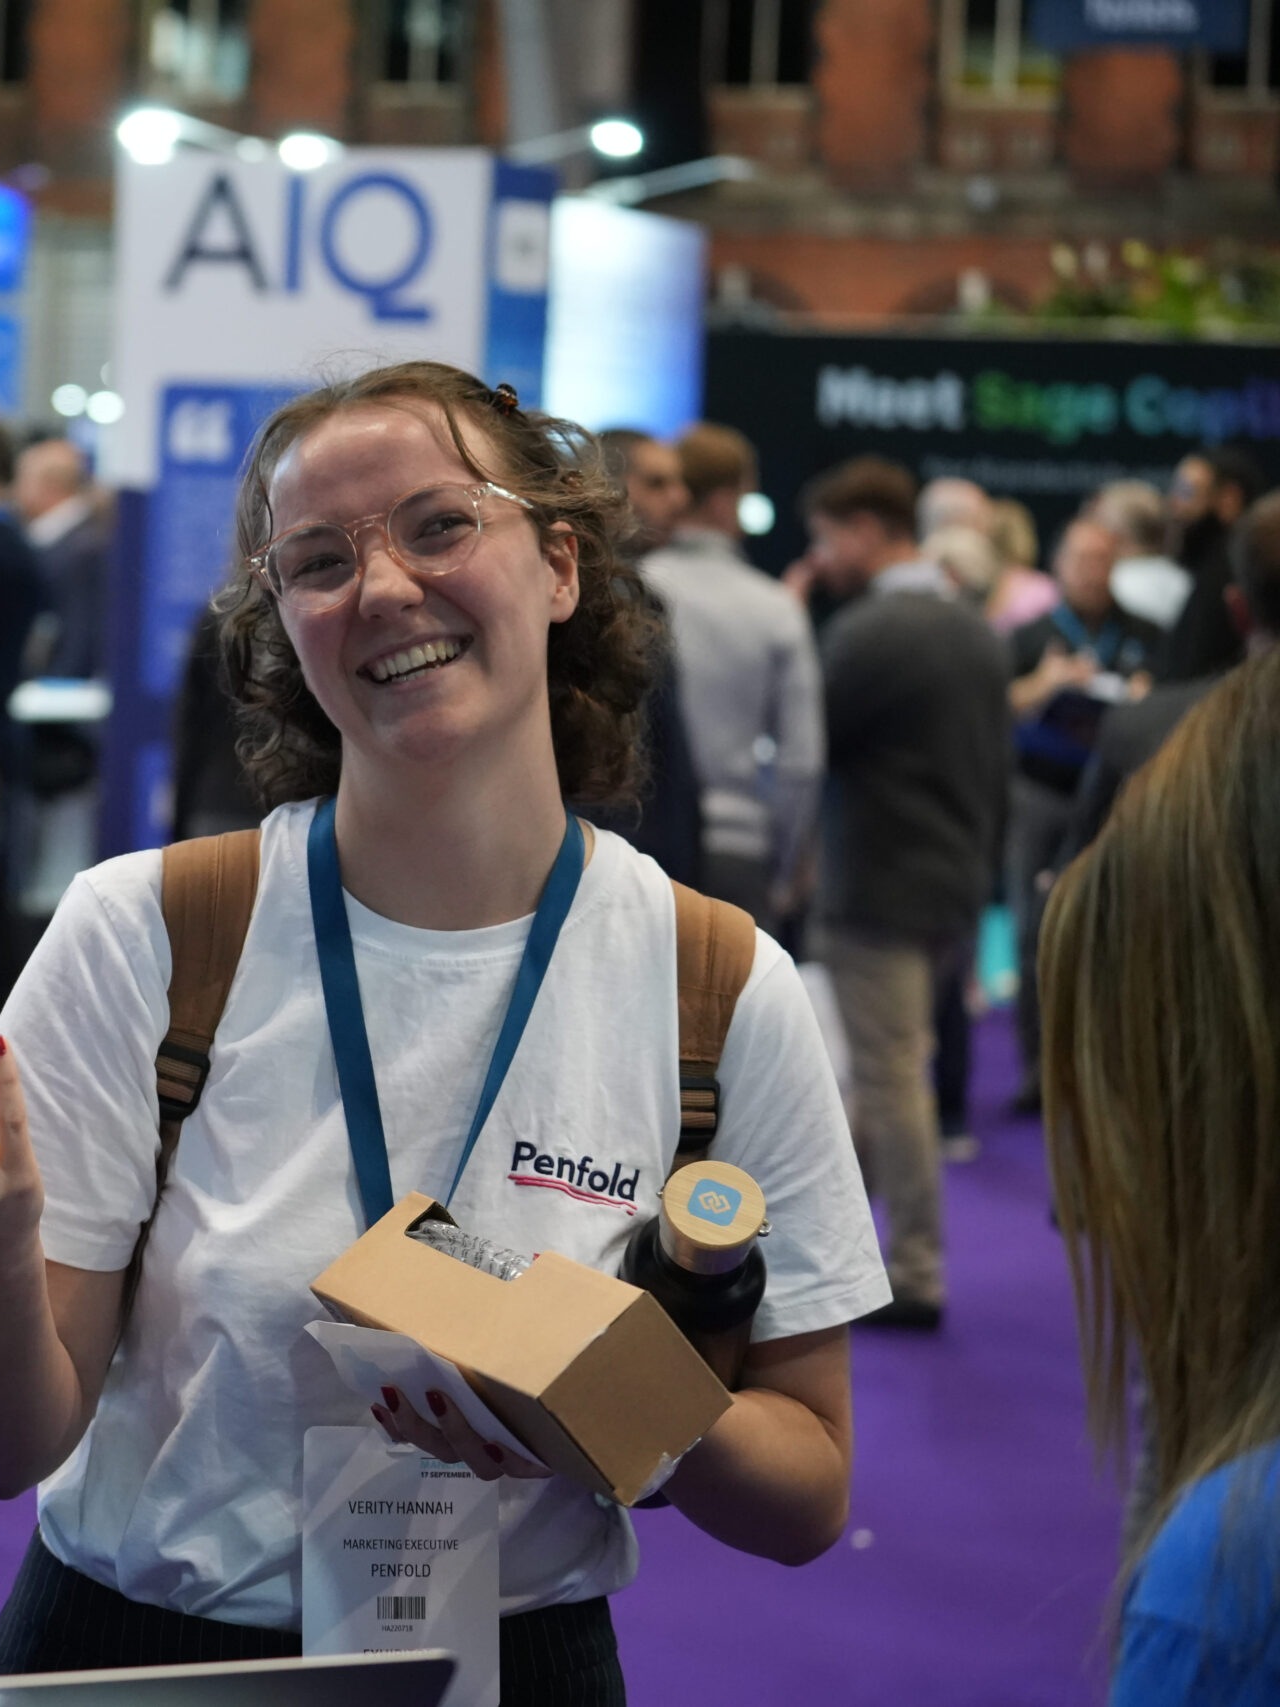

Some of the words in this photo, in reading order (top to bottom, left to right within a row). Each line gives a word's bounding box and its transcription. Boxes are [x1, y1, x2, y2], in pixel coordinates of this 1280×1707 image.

[163, 174, 433, 322] AIQ
[511, 1141, 640, 1201] Penfold
[348, 1501, 393, 1514] VERITY
[397, 1501, 453, 1514] HANNAH
[343, 1539, 402, 1550] MARKETING
[405, 1539, 458, 1550] EXECUTIVE
[371, 1564, 431, 1577] PENFOLD
